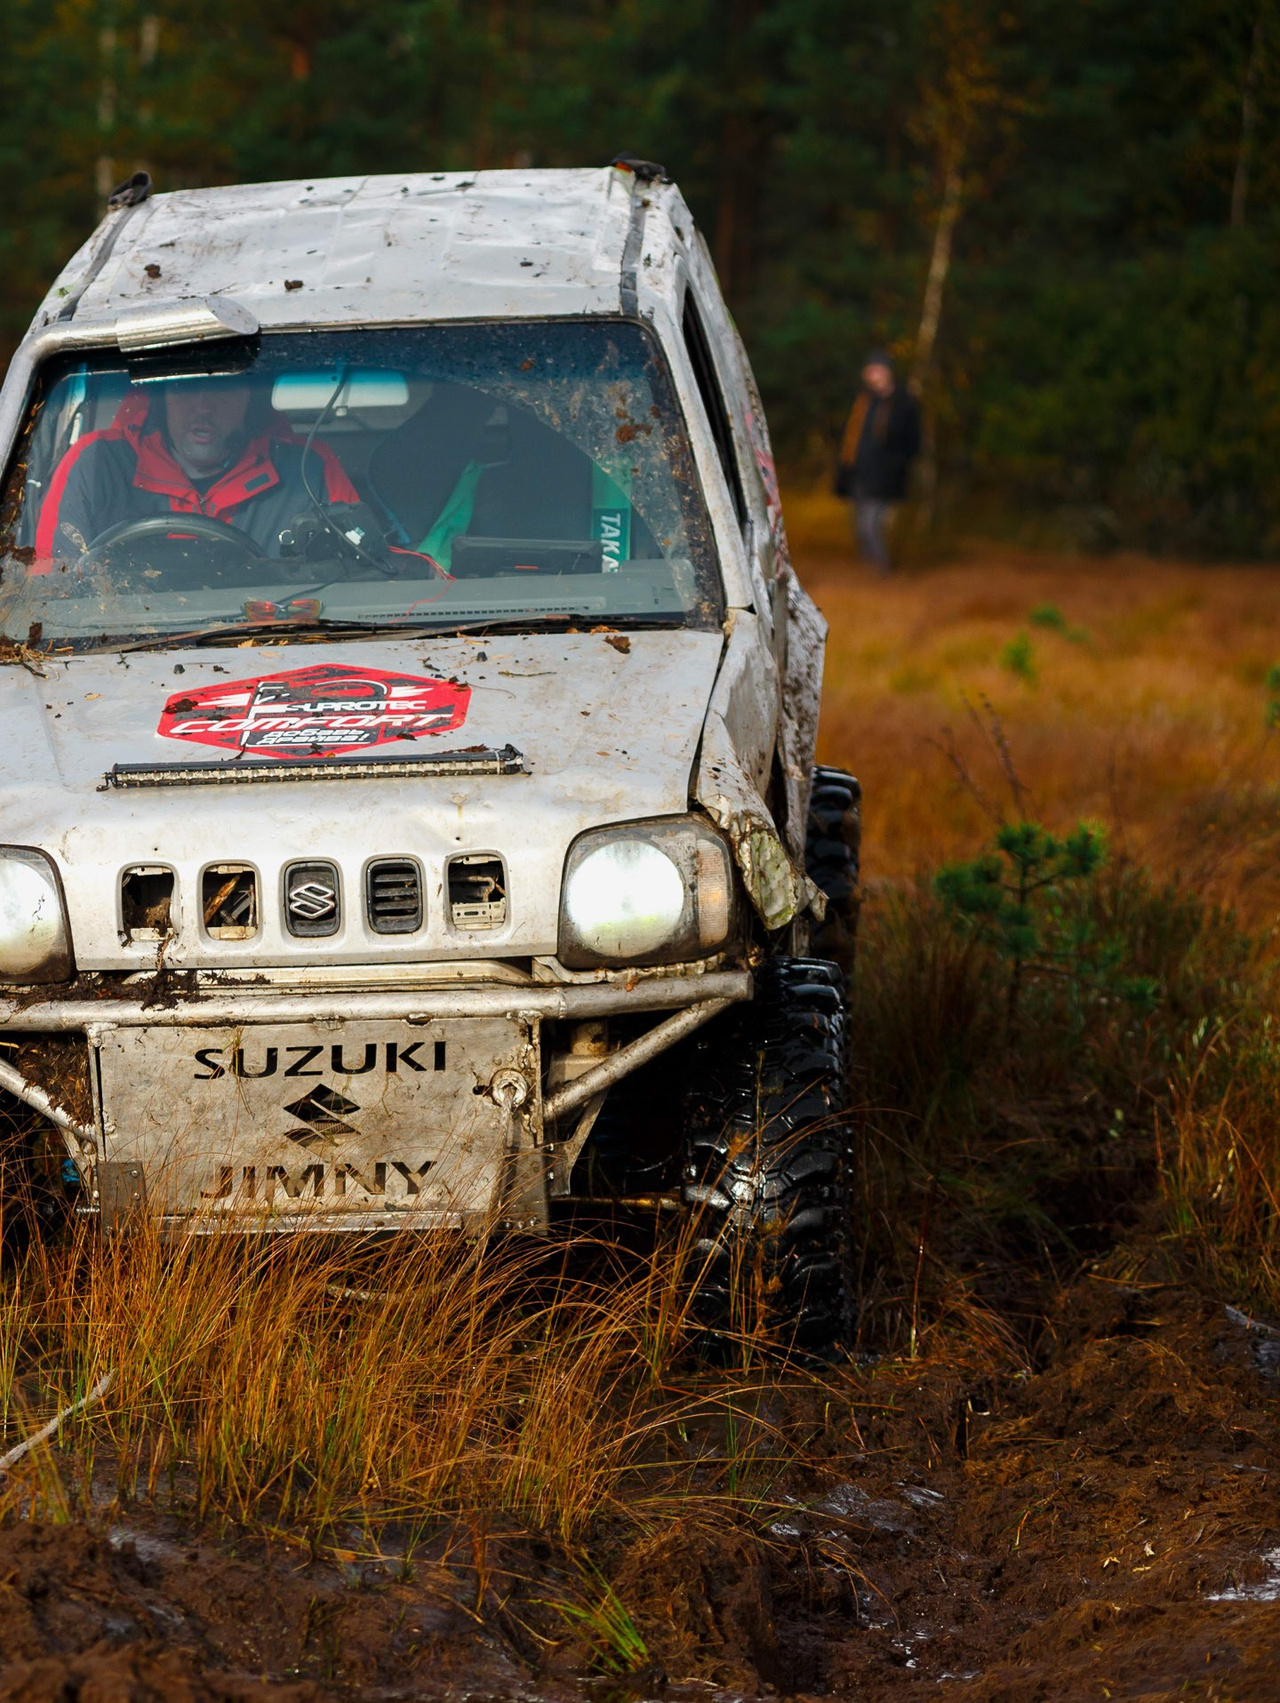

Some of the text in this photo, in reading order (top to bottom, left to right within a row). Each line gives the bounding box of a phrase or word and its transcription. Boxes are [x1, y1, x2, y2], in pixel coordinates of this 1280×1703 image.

[601, 513, 621, 574] TAKA
[169, 713, 454, 734] COMFORT
[283, 700, 428, 713] SUPROTEC
[194, 1041, 447, 1080] SUZUKI
[200, 1162, 438, 1199] JIMNY
